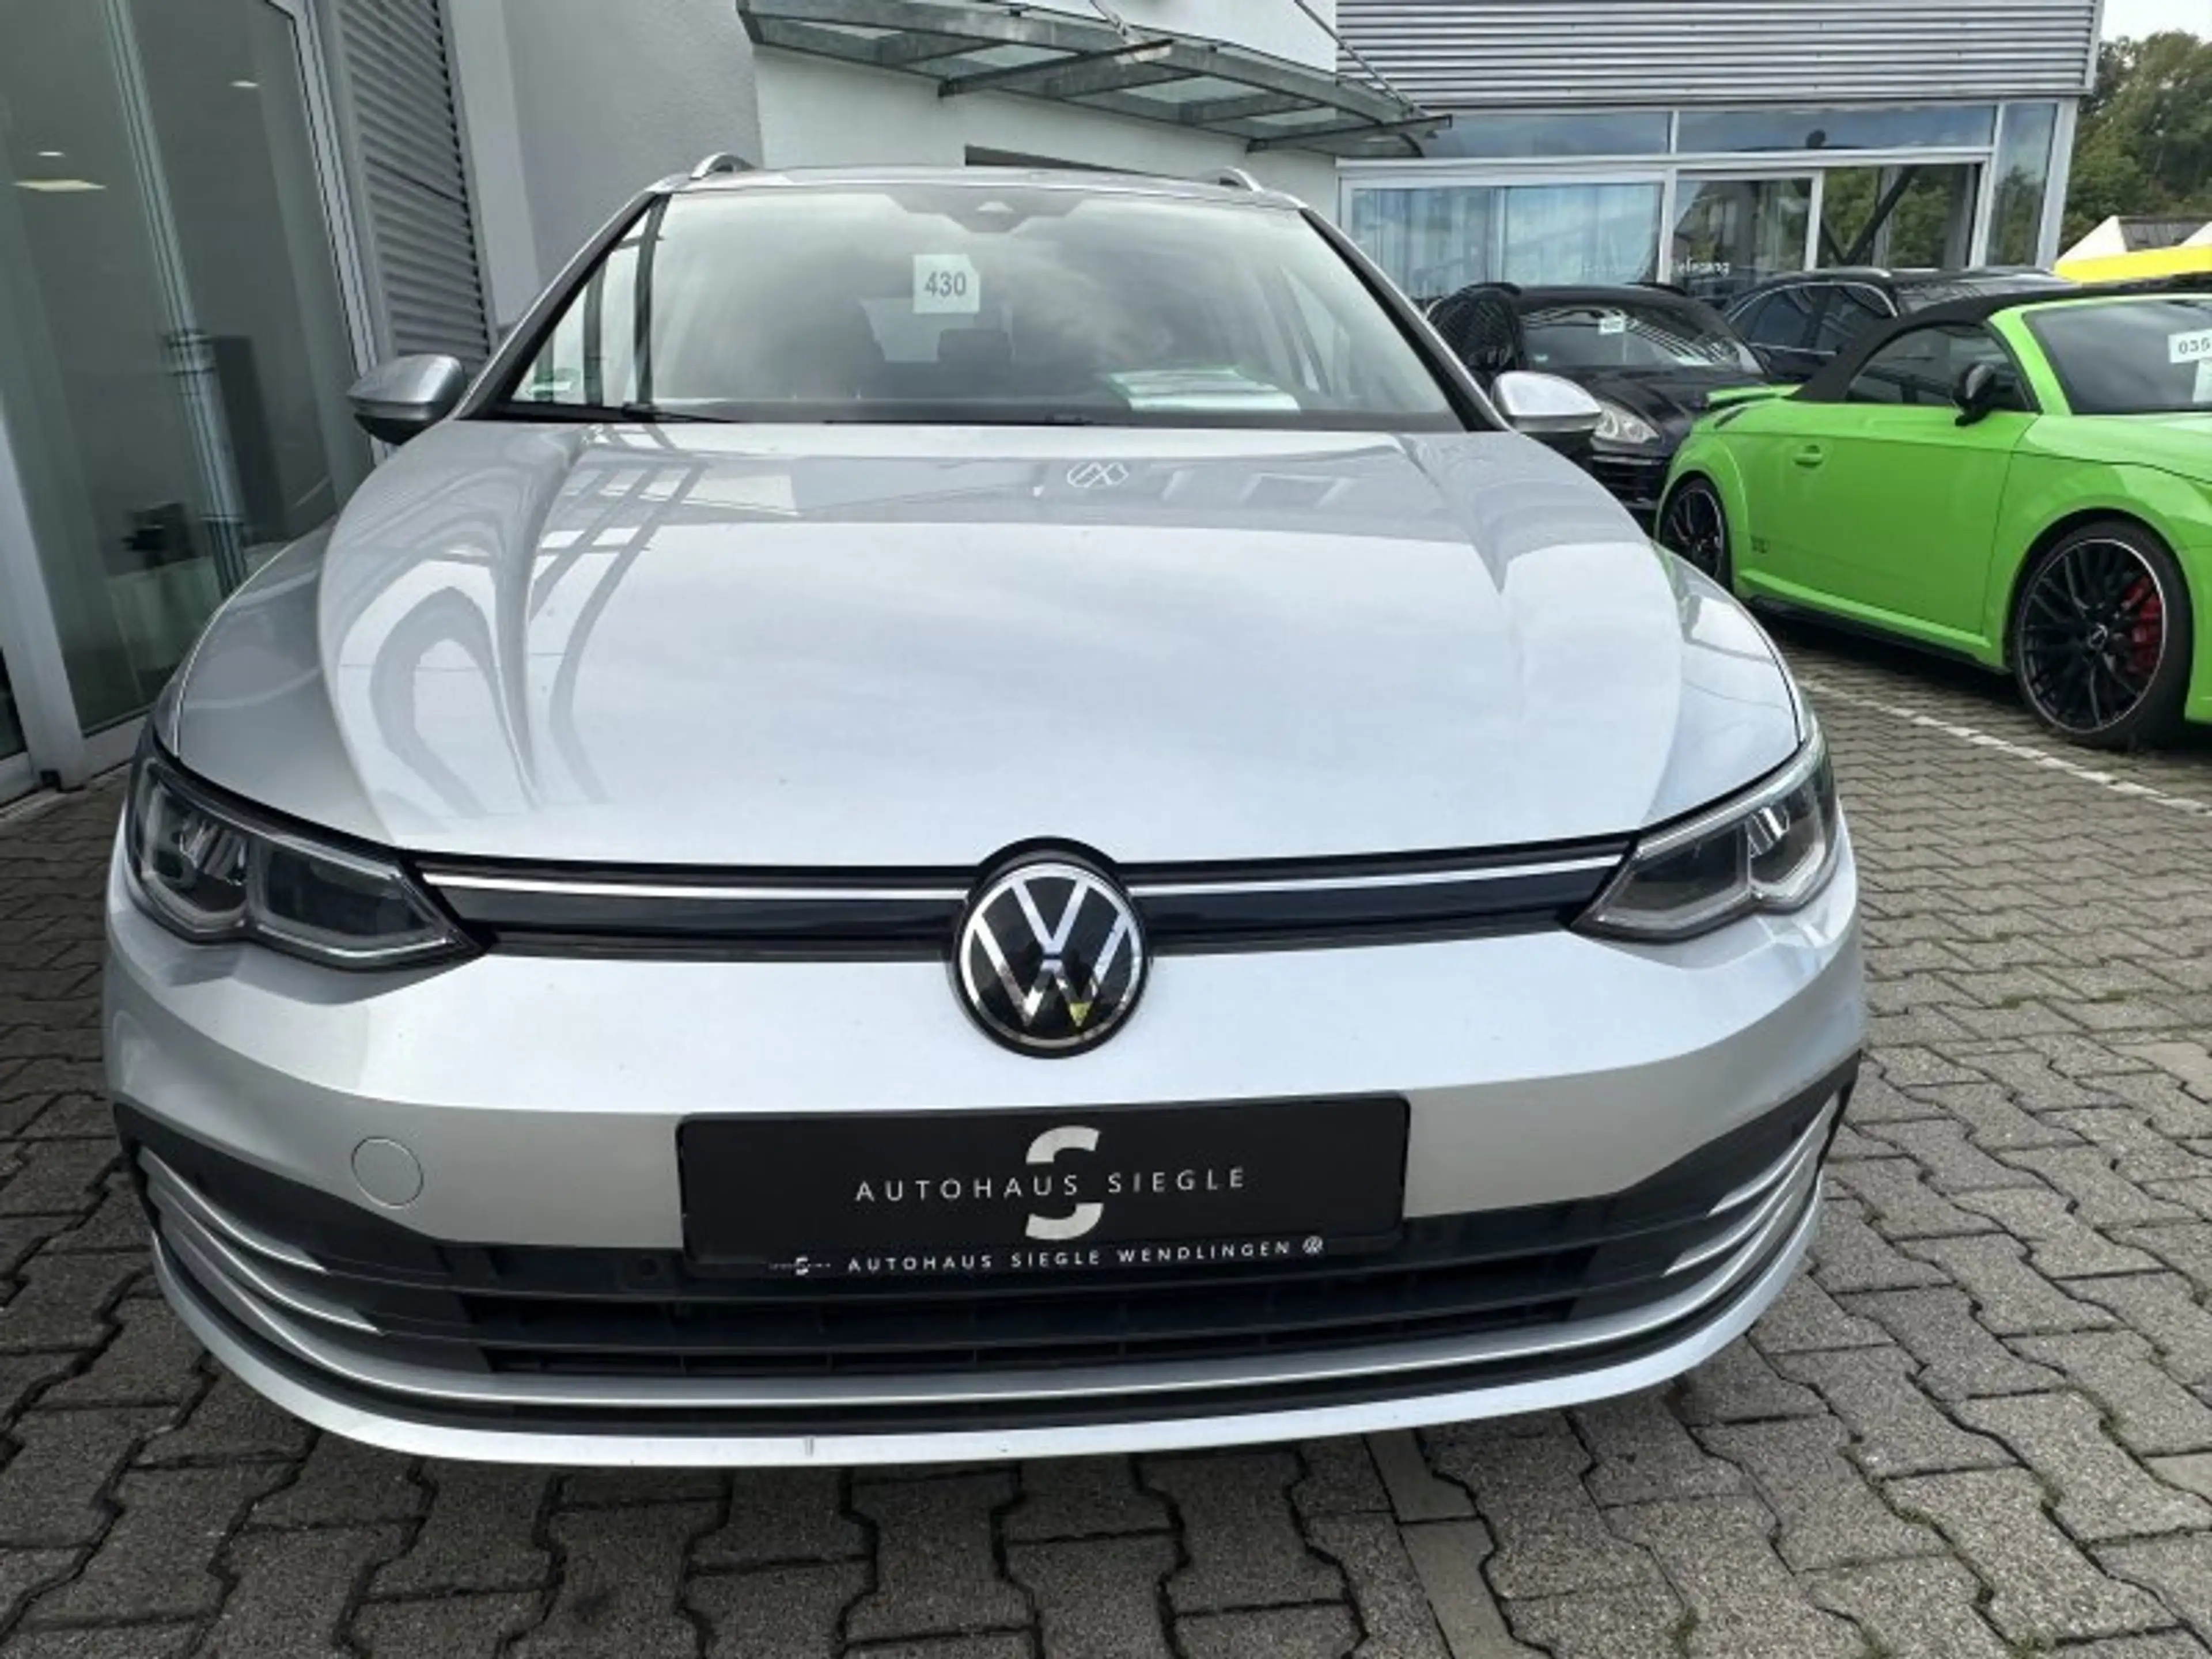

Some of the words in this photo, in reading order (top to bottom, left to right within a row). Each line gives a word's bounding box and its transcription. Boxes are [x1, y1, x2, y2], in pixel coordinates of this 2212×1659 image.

[923, 271, 967, 297] 430
[855, 1174, 1078, 1202] AUTOHAUS
[1107, 1166, 1244, 1194] SIEGLE
[847, 1253, 992, 1272] AUTOHAUS
[1010, 1249, 1100, 1267] SIEGLE
[1116, 1240, 1290, 1263] WENDLINGEN
